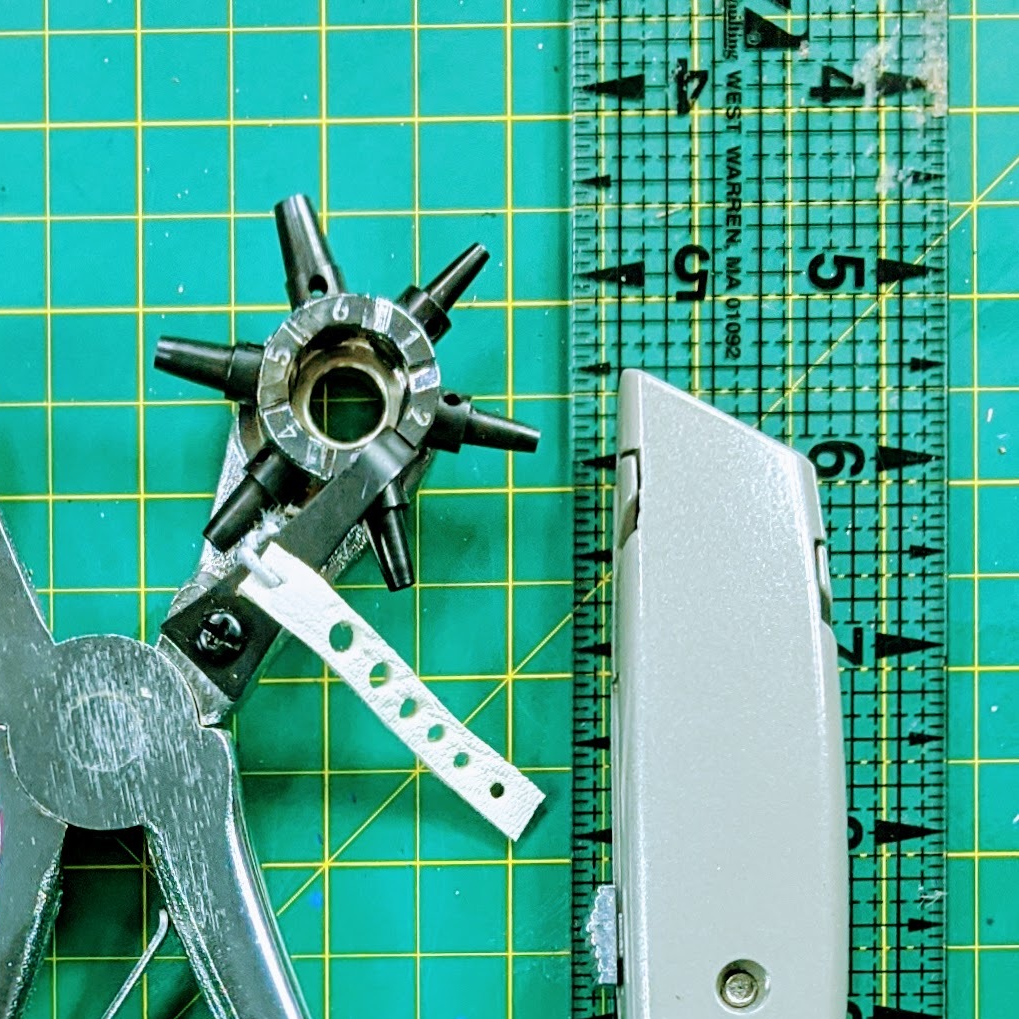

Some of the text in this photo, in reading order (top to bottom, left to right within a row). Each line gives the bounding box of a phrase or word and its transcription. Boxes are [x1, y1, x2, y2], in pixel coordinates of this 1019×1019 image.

[672, 58, 708, 117] 4
[809, 65, 866, 104] 4
[724, 70, 742, 359] WEST WARREN, MA 01092
[674, 244, 710, 301] 5
[808, 253, 865, 291] 5
[332, 297, 350, 321] 6
[808, 440, 865, 478] 6
